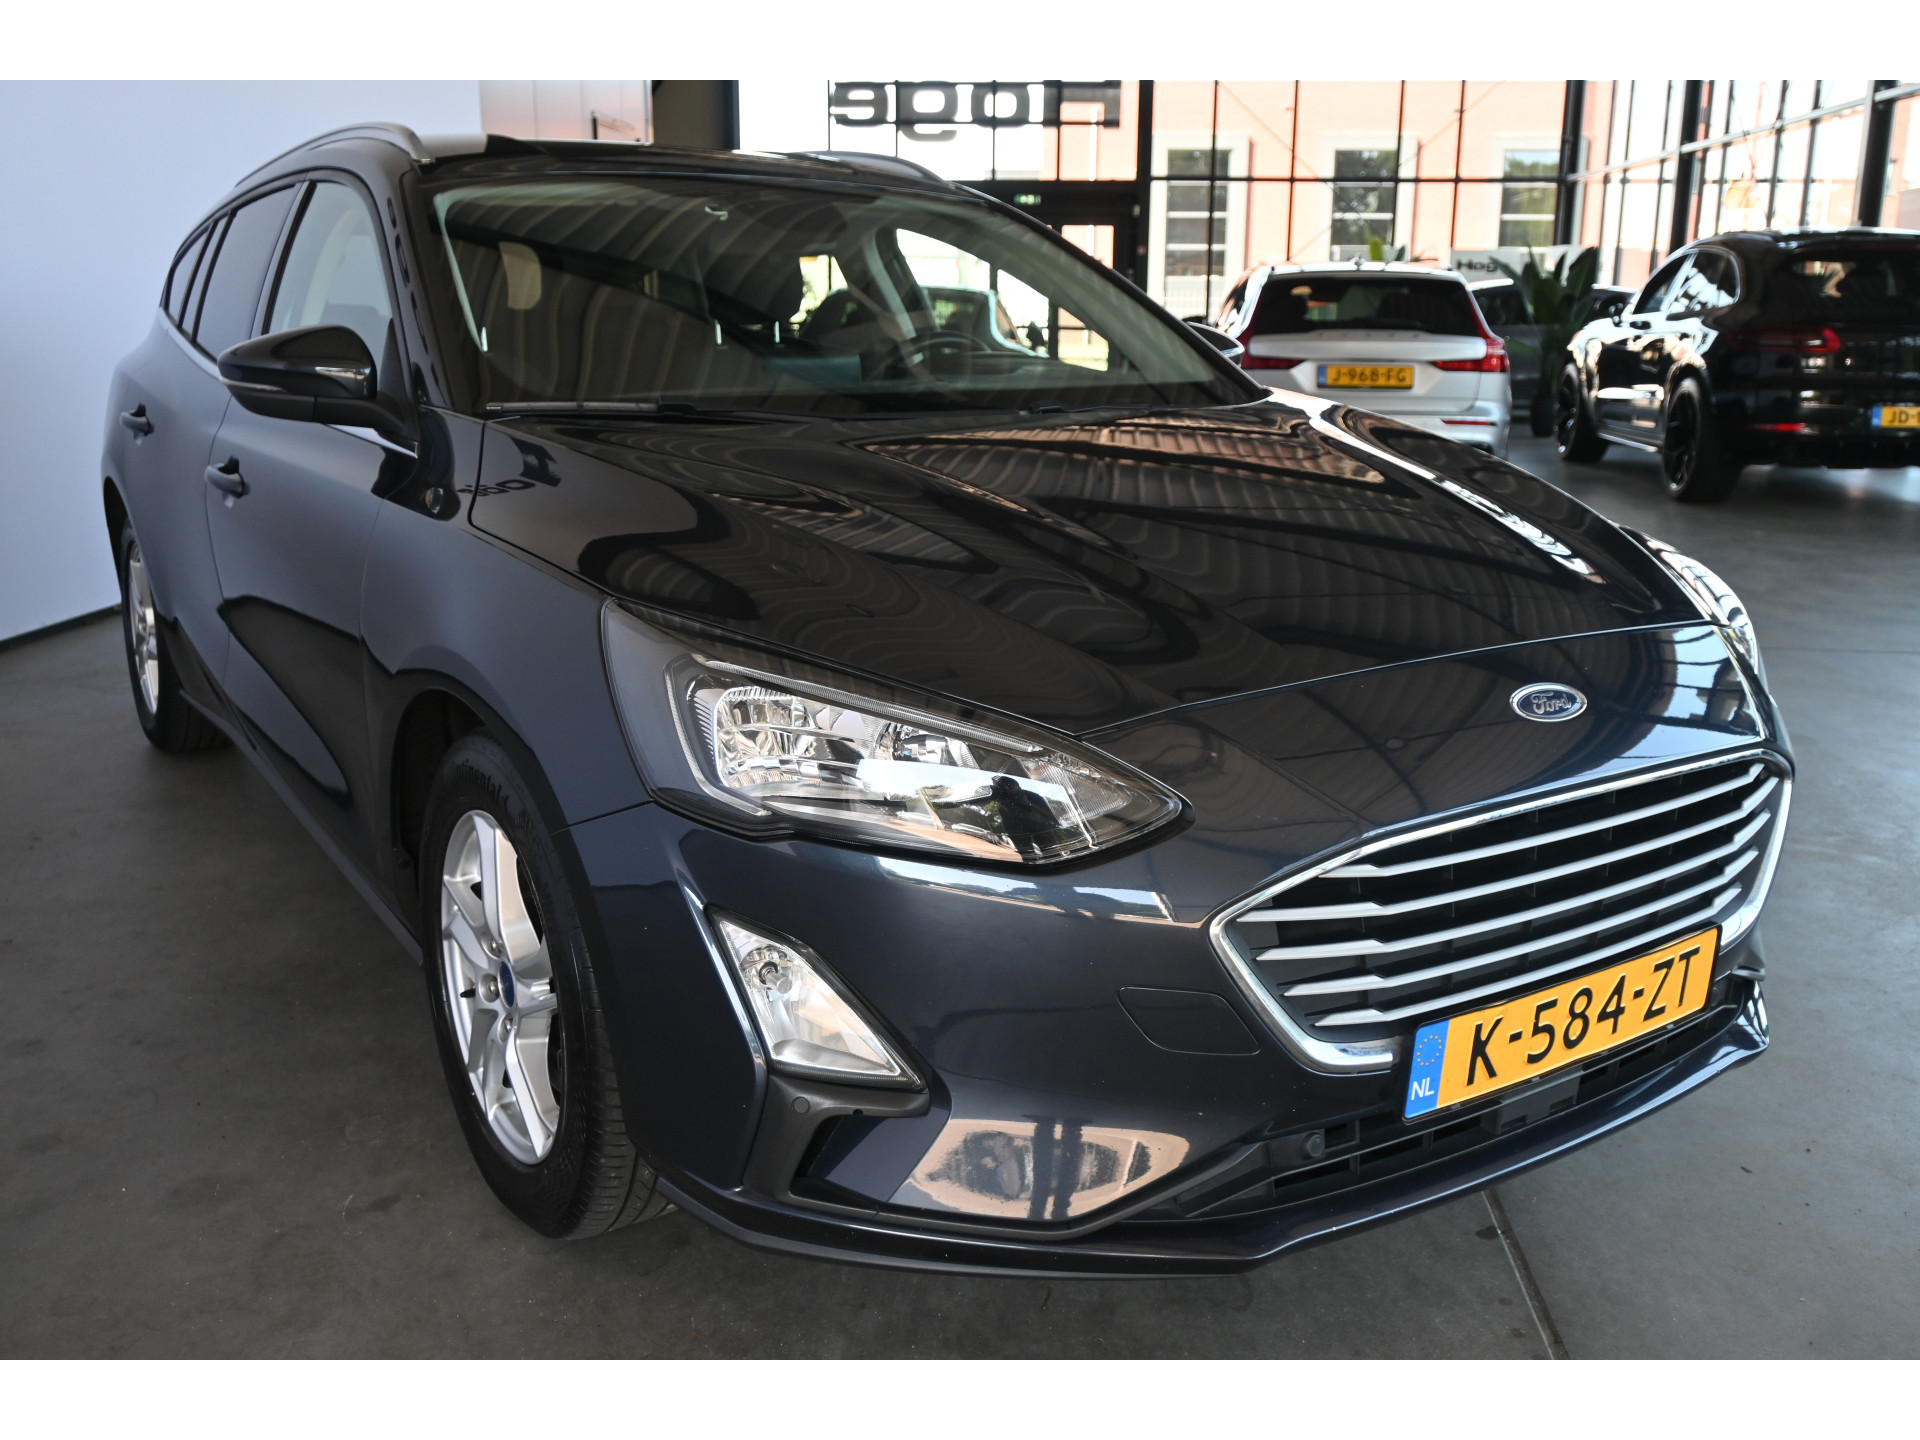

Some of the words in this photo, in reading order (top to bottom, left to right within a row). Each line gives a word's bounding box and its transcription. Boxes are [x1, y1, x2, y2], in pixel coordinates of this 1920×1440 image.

[1456, 258, 1500, 273] Hog
[1332, 367, 1407, 383] J-968-FG
[1531, 691, 1572, 715] Ford
[1466, 944, 1700, 1087] K-584-ZT
[1410, 1077, 1435, 1100] NL
